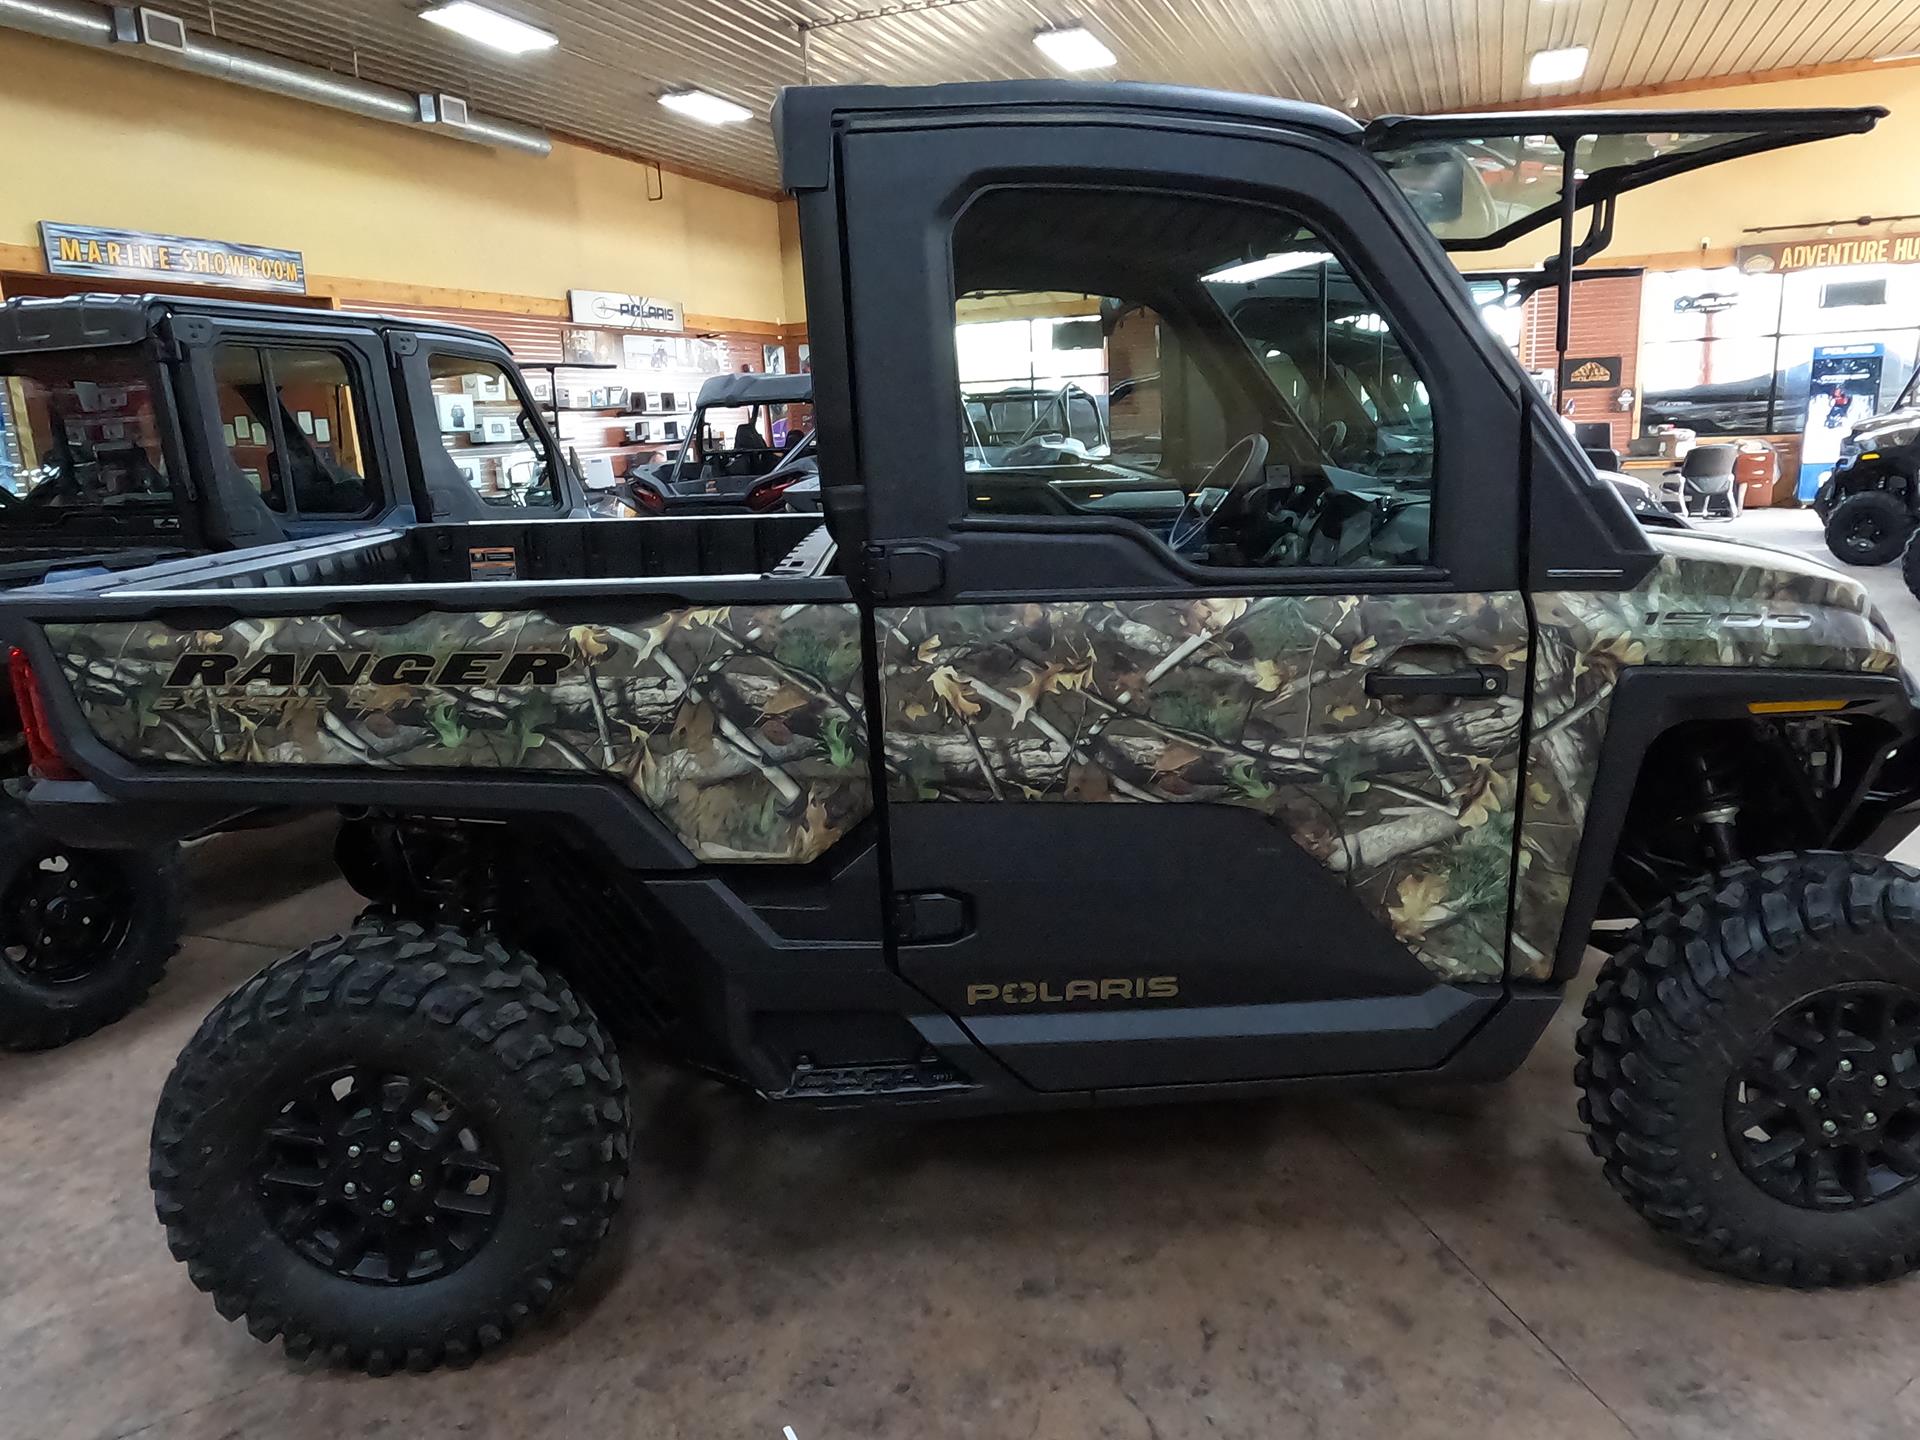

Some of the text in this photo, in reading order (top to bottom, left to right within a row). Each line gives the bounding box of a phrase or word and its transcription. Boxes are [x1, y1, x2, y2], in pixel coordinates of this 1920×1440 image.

[59, 237, 299, 283] MARINE SHOWROOM
[1779, 239, 1890, 269] ADVENTURE
[619, 303, 674, 321] POLARIS
[1644, 611, 1814, 629] 1500
[163, 652, 571, 688] RANGER
[966, 976, 1179, 1006] POLARIS
